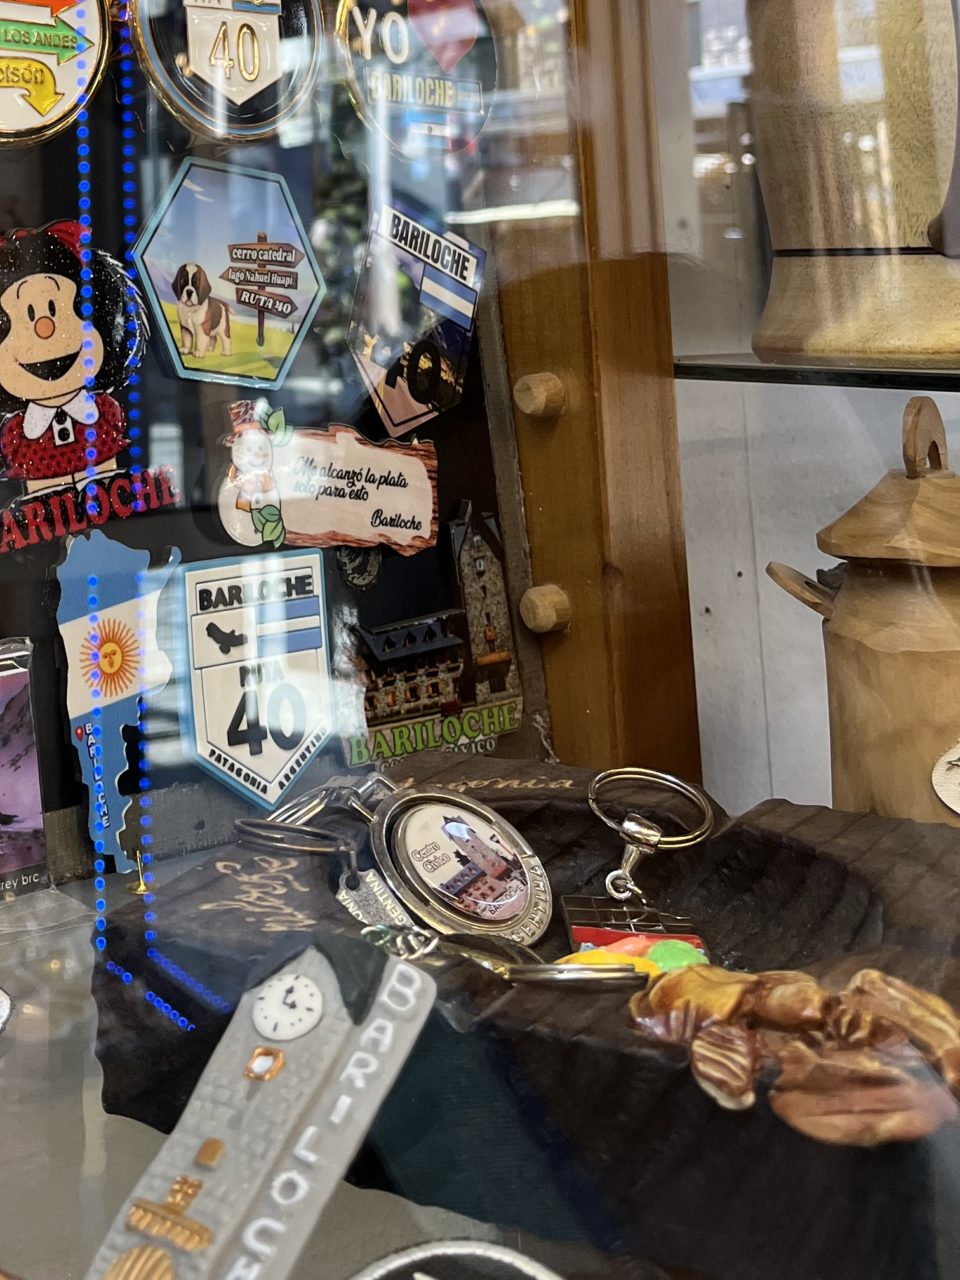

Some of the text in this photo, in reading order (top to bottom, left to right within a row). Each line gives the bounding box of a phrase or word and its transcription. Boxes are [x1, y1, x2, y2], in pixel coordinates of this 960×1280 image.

[3, 27, 29, 45] LOS
[31, 30, 78, 50] ANDES
[351, 5, 410, 65] YO
[208, 21, 261, 82] 40
[370, 70, 454, 108] BARILOCHE
[232, 247, 296, 262] cerro catedral
[390, 213, 470, 281] BARILOCHE
[229, 268, 244, 283] lago
[245, 270, 271, 283] Nahuel
[240, 290, 292, 314] RUTA 40
[319, 462, 362, 488] alcanzó
[365, 467, 378, 485] la
[376, 469, 409, 490] plata
[315, 484, 347, 501] para
[348, 486, 369, 502] esto
[370, 508, 423, 531] Bariloche
[239, 658, 286, 688] RUTA
[226, 682, 307, 756] 40
[349, 702, 518, 767] BARILOCHE
[208, 748, 269, 796] PATAGONIA
[277, 724, 328, 792] ARGENTINA
[21, 872, 40, 885] brc
